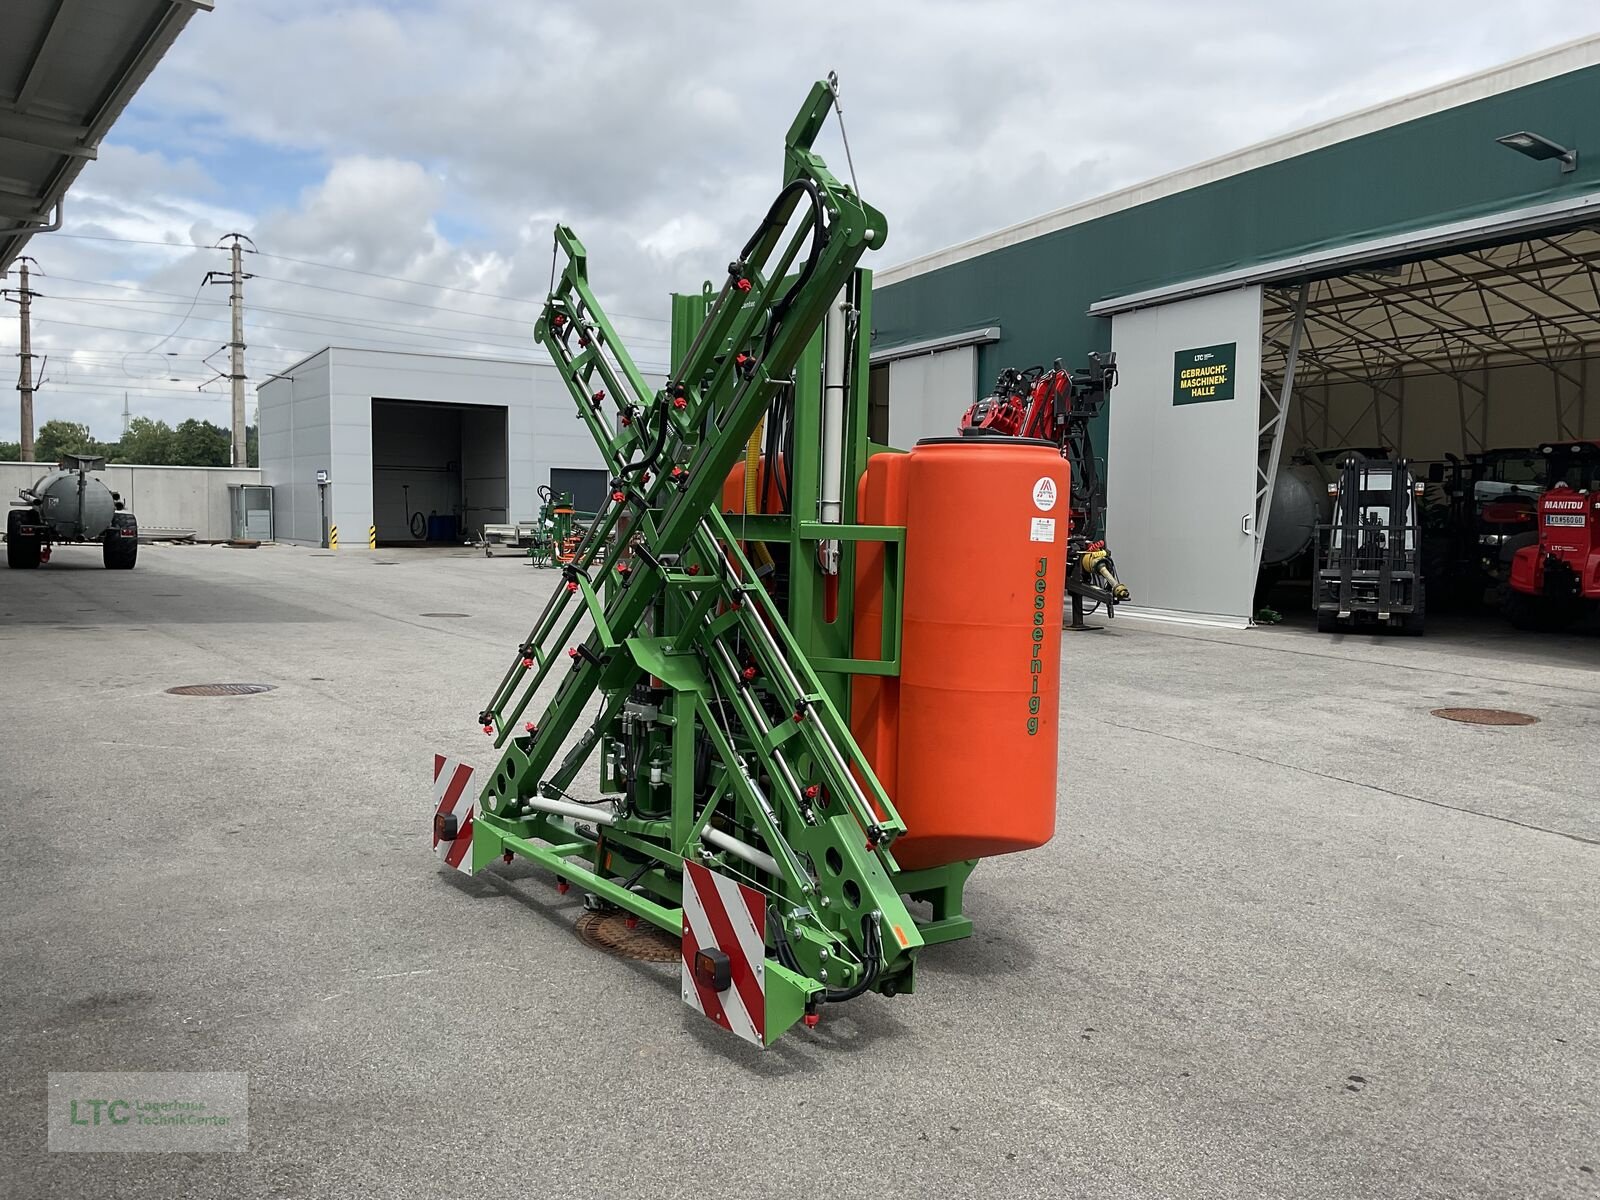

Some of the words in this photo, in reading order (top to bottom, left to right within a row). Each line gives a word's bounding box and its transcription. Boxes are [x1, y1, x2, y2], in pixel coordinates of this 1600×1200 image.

[1181, 364, 1228, 379] GEBRAUCHT-
[1180, 375, 1228, 389] MASCHINEN-
[1191, 386, 1216, 397] HALLE
[1544, 501, 1584, 509] MANITOU
[1027, 557, 1048, 736] Jessernigg
